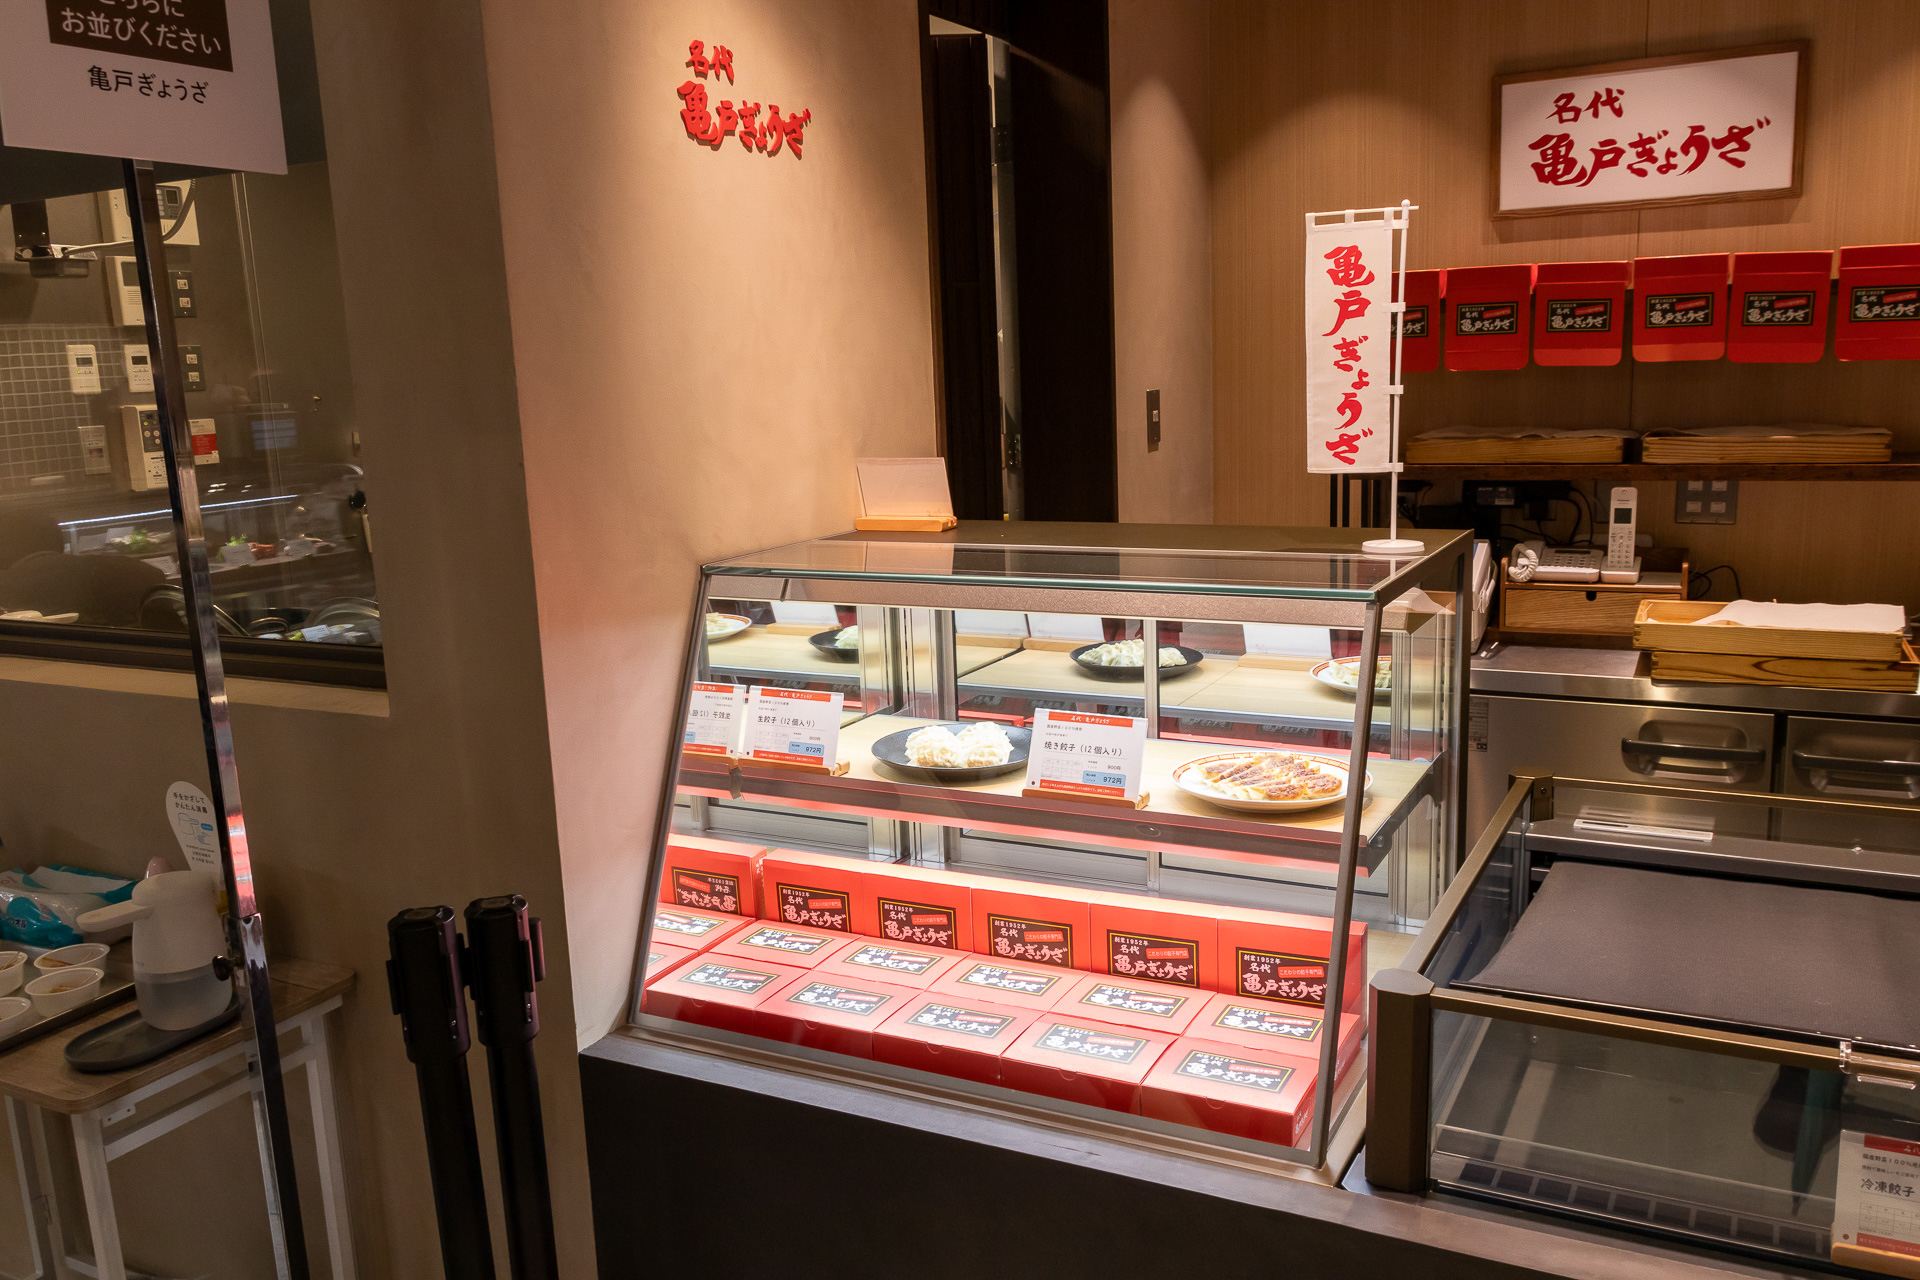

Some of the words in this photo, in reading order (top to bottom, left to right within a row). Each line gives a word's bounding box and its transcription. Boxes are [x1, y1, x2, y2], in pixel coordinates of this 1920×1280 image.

[61, 7, 222, 55] お並びください
[685, 39, 735, 85] 名代
[87, 65, 209, 104] 亀戸ぎょうざ
[1546, 87, 1625, 124] 名代
[677, 80, 811, 159] 亀戸ぎょうざ
[1528, 115, 1771, 187] 亀戸ぎょうざ
[1322, 245, 1375, 465] 亀戸ぎょうざ
[805, 746, 822, 754] 972円
[1103, 776, 1122, 785] 972円
[787, 896, 803, 905] 名代
[783, 904, 847, 928] 亀戸ぎょうざ
[889, 911, 906, 921] 名代
[884, 920, 953, 945] 亀戸ぎょうざ
[1000, 927, 1018, 938] 名代
[994, 937, 1068, 963] 亀戸ぎょうざ
[1120, 944, 1140, 955] 名代
[1243, 954, 1281, 965] 創業1952年
[1113, 954, 1194, 981] 亀戸ぎょうざ
[1249, 962, 1271, 973] 名代
[1242, 972, 1328, 1001] 亀戸ぎょうざ
[1860, 1178, 1915, 1198] 冷凍餃子
